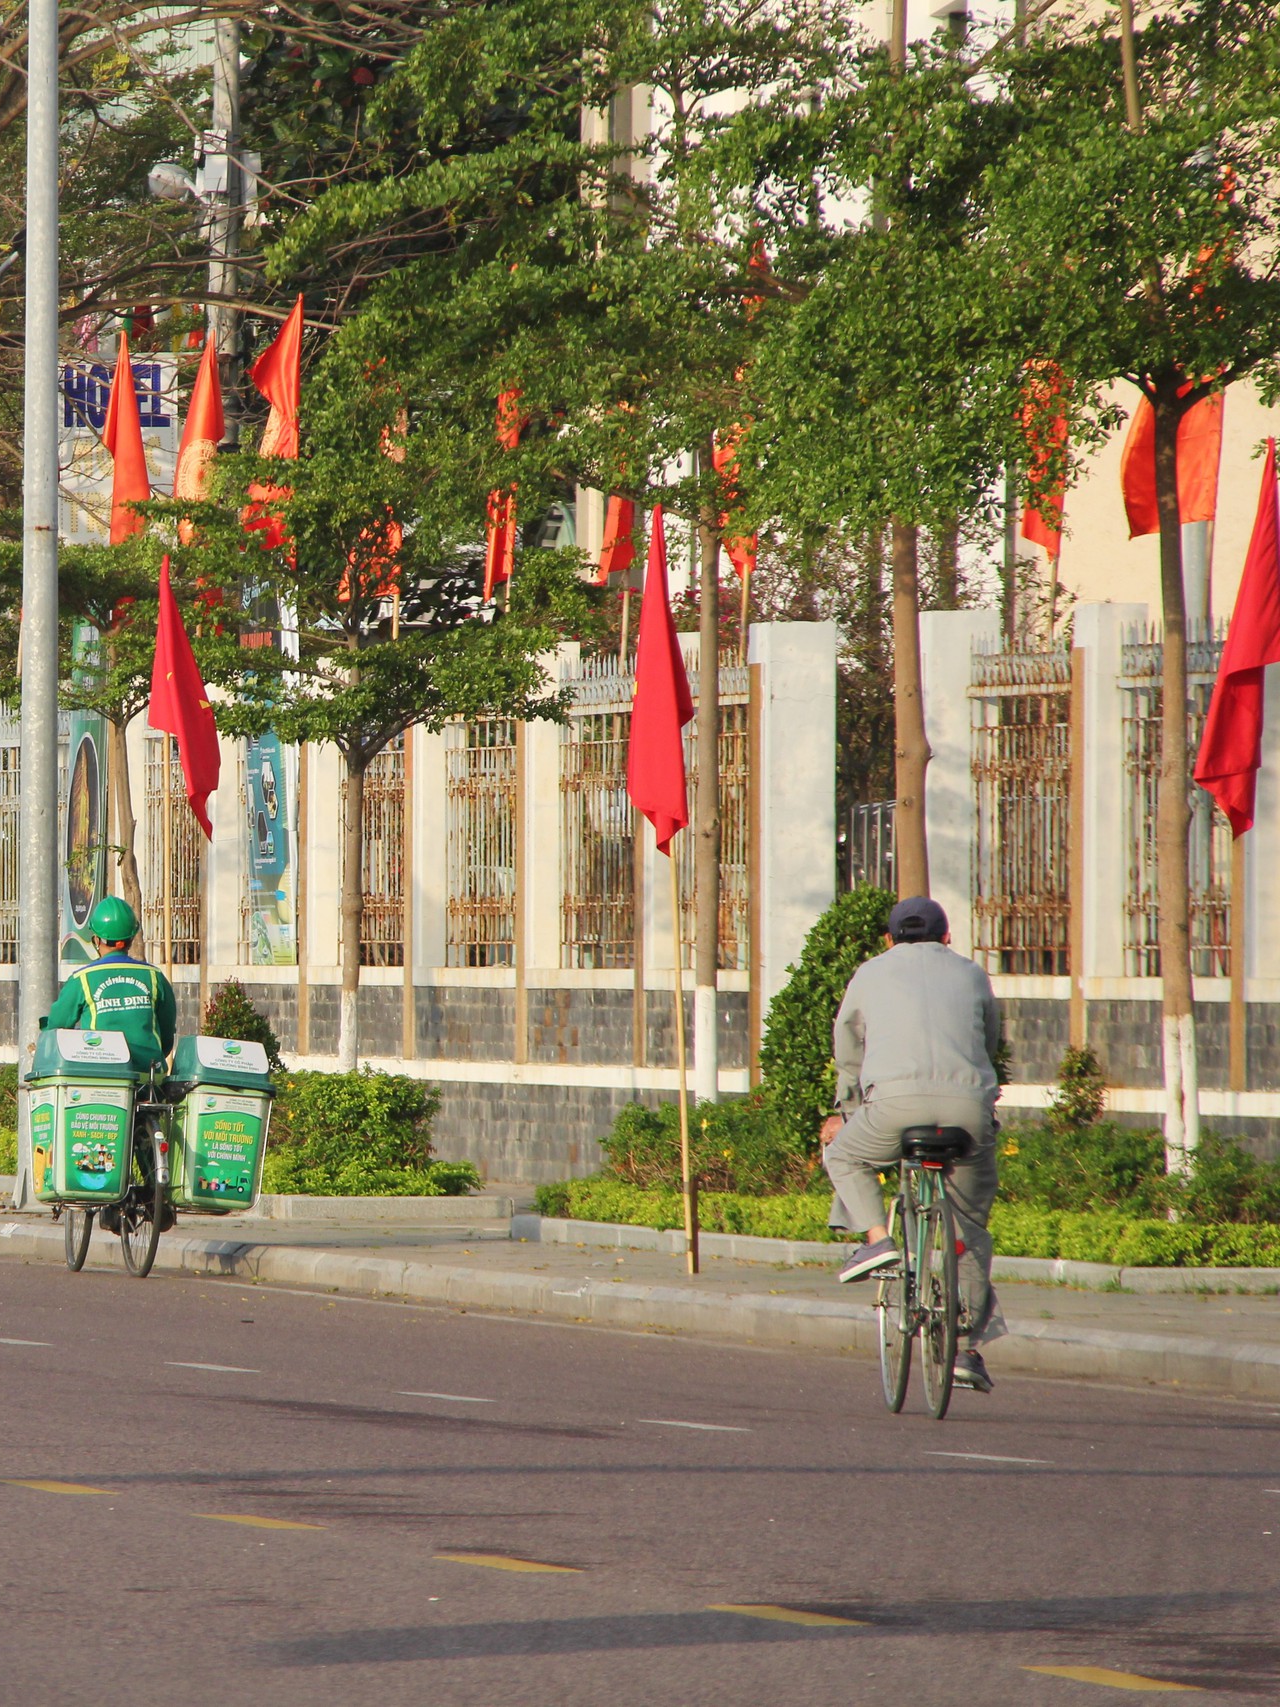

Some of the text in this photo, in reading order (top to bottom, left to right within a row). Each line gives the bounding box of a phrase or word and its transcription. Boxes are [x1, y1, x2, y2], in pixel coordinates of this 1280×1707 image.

[64, 363, 170, 428] HOEL
[215, 1119, 245, 1132] SỐNG TỐT
